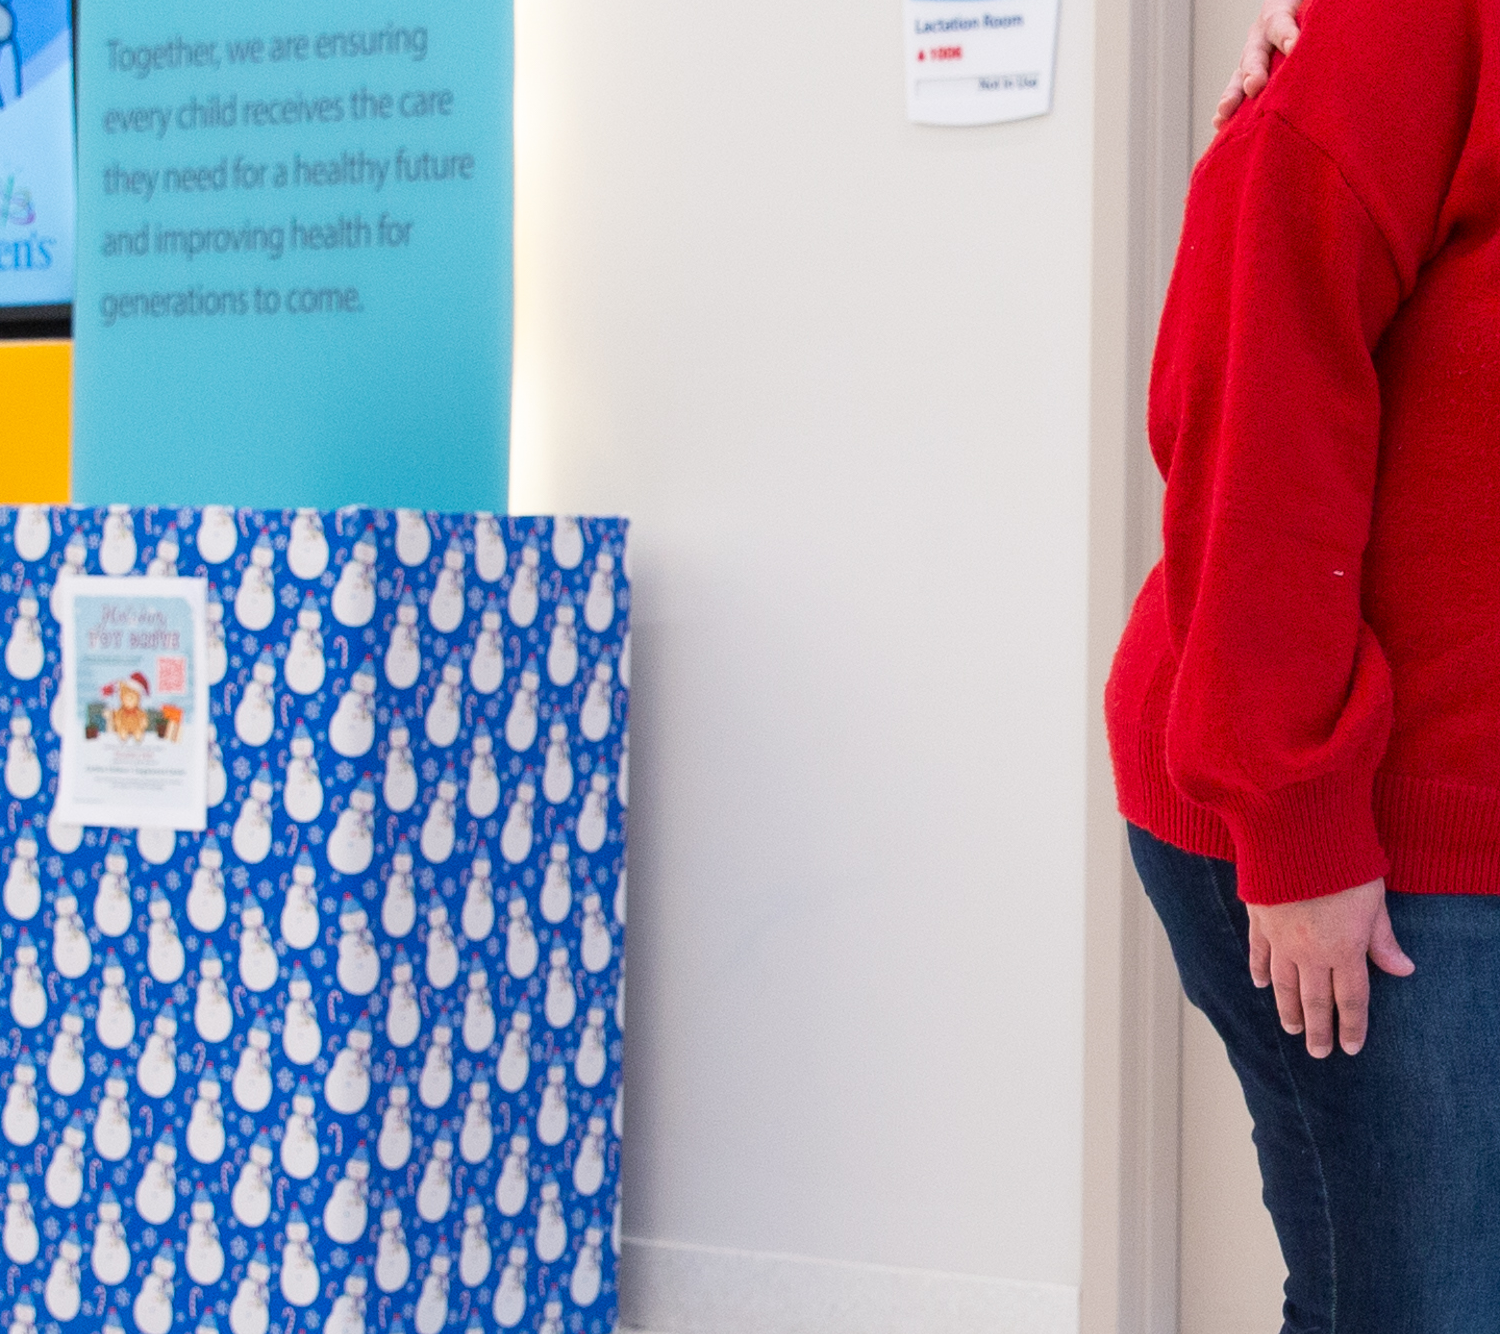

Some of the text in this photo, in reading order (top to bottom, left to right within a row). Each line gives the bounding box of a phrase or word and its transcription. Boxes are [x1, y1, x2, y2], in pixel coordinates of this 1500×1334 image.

[106, 23, 429, 80] Together, we are ensuring
[914, 17, 979, 35] Lactation
[102, 84, 455, 140] every child receives the care
[102, 144, 476, 203] they need for a healthy future
[102, 211, 415, 261] and improving health for
[101, 284, 364, 328] generations to come.
